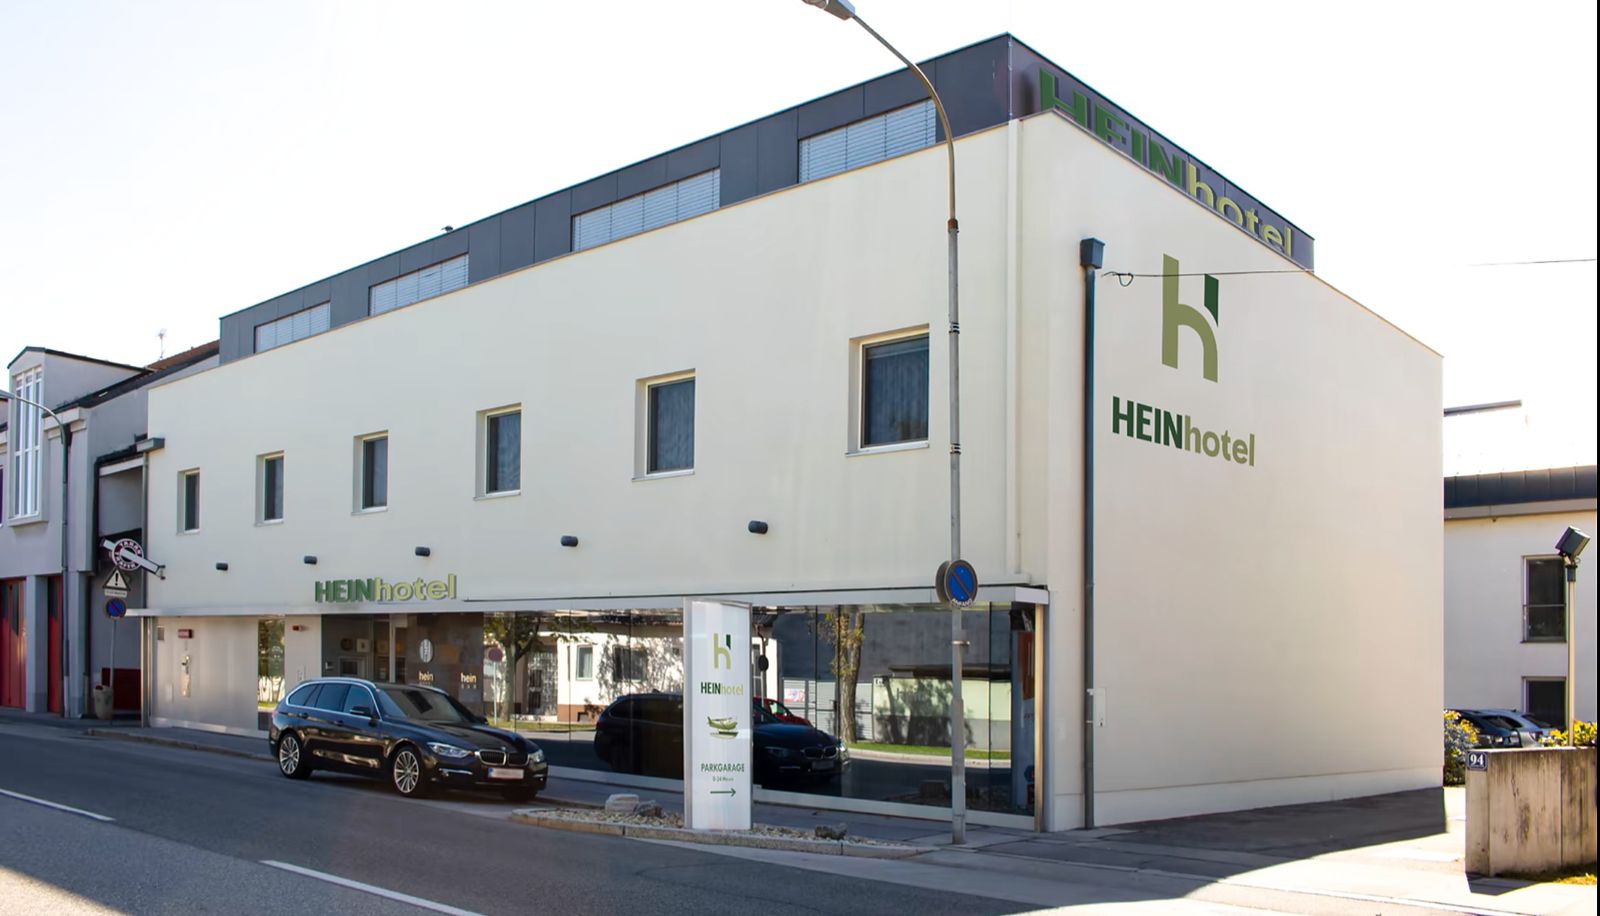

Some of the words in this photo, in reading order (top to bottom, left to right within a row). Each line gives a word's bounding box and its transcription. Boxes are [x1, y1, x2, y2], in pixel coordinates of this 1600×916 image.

[1039, 67, 1292, 257] HEINhotel
[1112, 396, 1255, 467] HEINhotel
[315, 574, 457, 602] HEINhotel
[418, 671, 434, 681] hein
[460, 672, 477, 683] hein
[701, 682, 744, 696] HEINhotel
[1470, 753, 1484, 765] 94
[701, 763, 745, 772] PARKGARAGE
